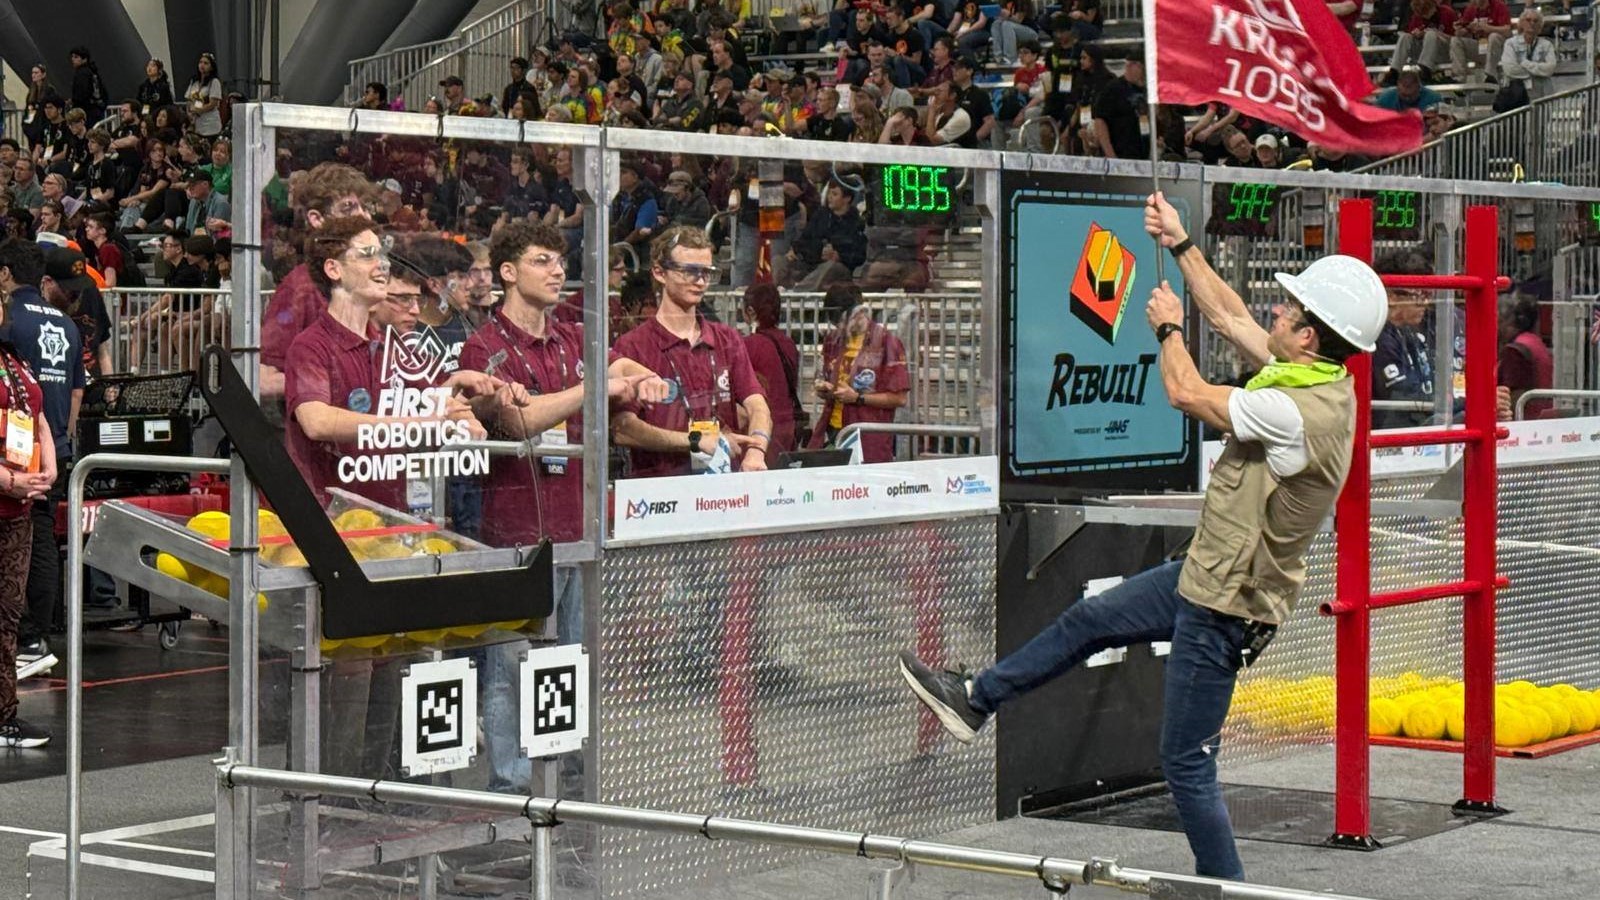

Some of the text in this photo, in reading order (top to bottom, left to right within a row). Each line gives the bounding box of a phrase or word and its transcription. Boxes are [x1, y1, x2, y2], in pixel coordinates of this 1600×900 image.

[884, 165, 950, 211] 10935
[1226, 182, 1277, 222] SAFE
[1376, 191, 1415, 227] 3256
[1046, 353, 1157, 411] REBUILT
[377, 387, 453, 419] FIRST
[357, 419, 472, 450] ROBOTICS
[338, 448, 489, 483] COMPETITION
[649, 494, 750, 515] FIRST Honeywell
[832, 483, 869, 501] molex
